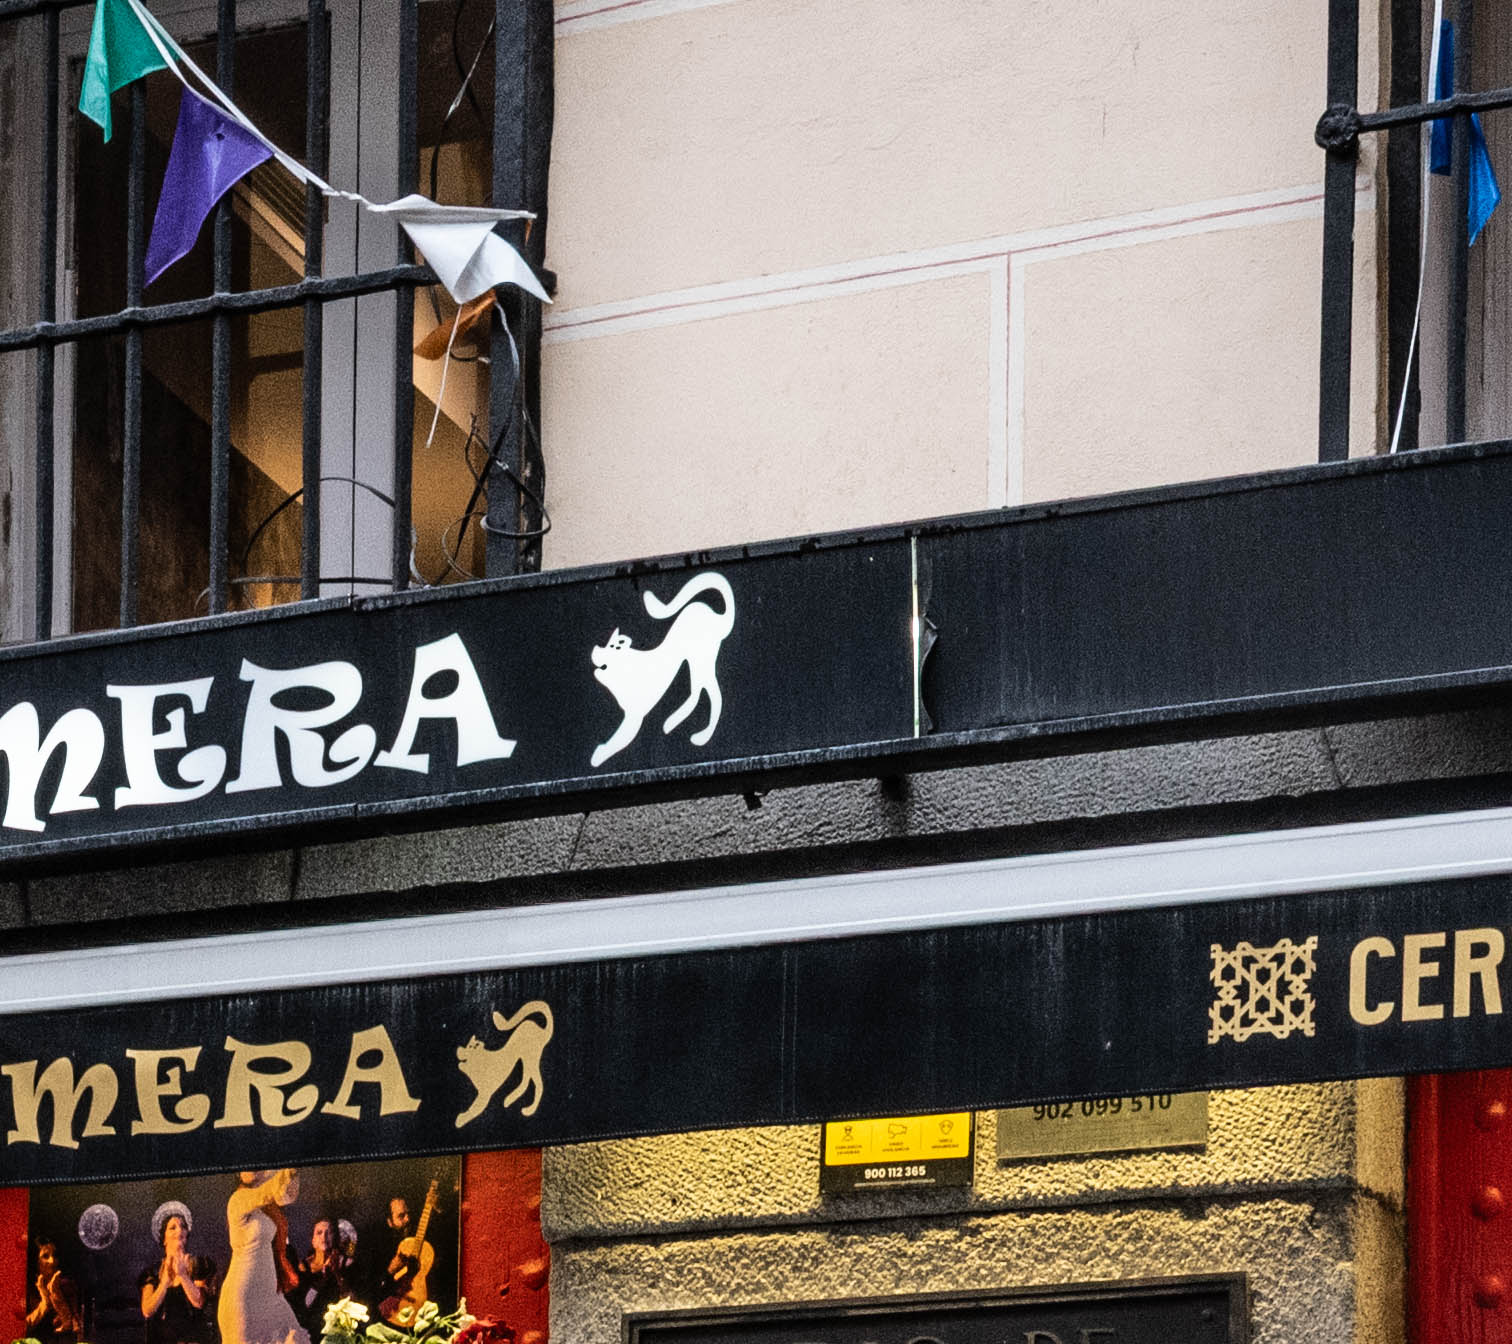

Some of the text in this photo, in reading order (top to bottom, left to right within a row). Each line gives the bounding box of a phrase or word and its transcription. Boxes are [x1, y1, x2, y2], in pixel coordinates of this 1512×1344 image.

[1032, 1102, 1074, 1121] 902
[1081, 1097, 1123, 1117] 099
[864, 1165, 926, 1180] 900 112 365
